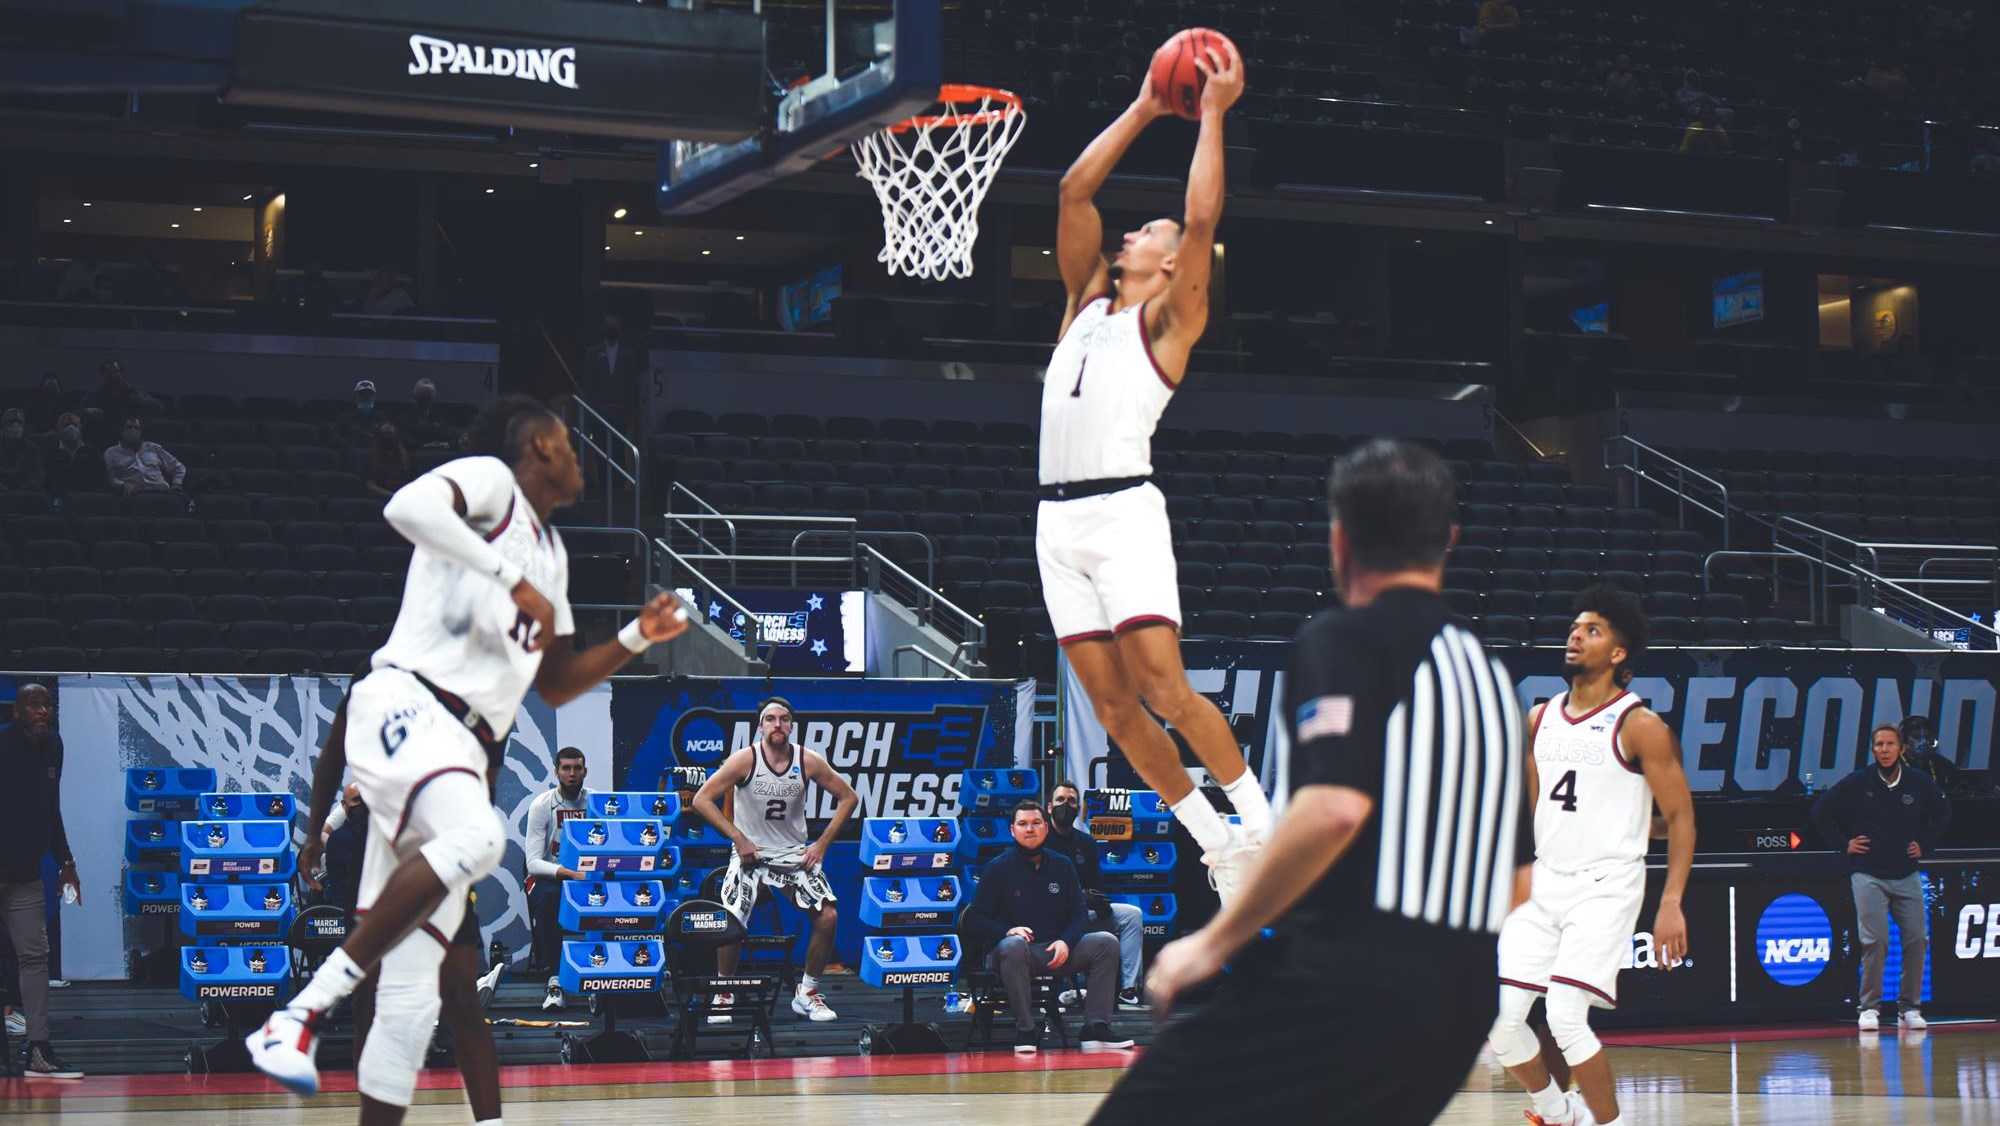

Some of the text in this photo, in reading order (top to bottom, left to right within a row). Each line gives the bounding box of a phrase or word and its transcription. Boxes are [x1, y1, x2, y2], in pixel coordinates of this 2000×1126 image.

[408, 34, 580, 89] SPALDING
[1070, 353, 1088, 398] 1
[653, 370, 664, 397] 5
[686, 739, 724, 752] NCAA
[1536, 738, 1605, 766] ZAGS
[754, 780, 801, 797] ZAGS
[1550, 770, 1577, 812] 4
[764, 800, 787, 821] 2
[234, 921, 261, 929] POWER
[313, 919, 339, 927] MARCH
[690, 914, 714, 922] MARCH
[693, 920, 727, 929] MADNESS
[1763, 937, 1830, 964] NCAA
[583, 978, 652, 990] POWERADE
[885, 973, 950, 984] POWERADE
[200, 986, 275, 998] POWERADE
